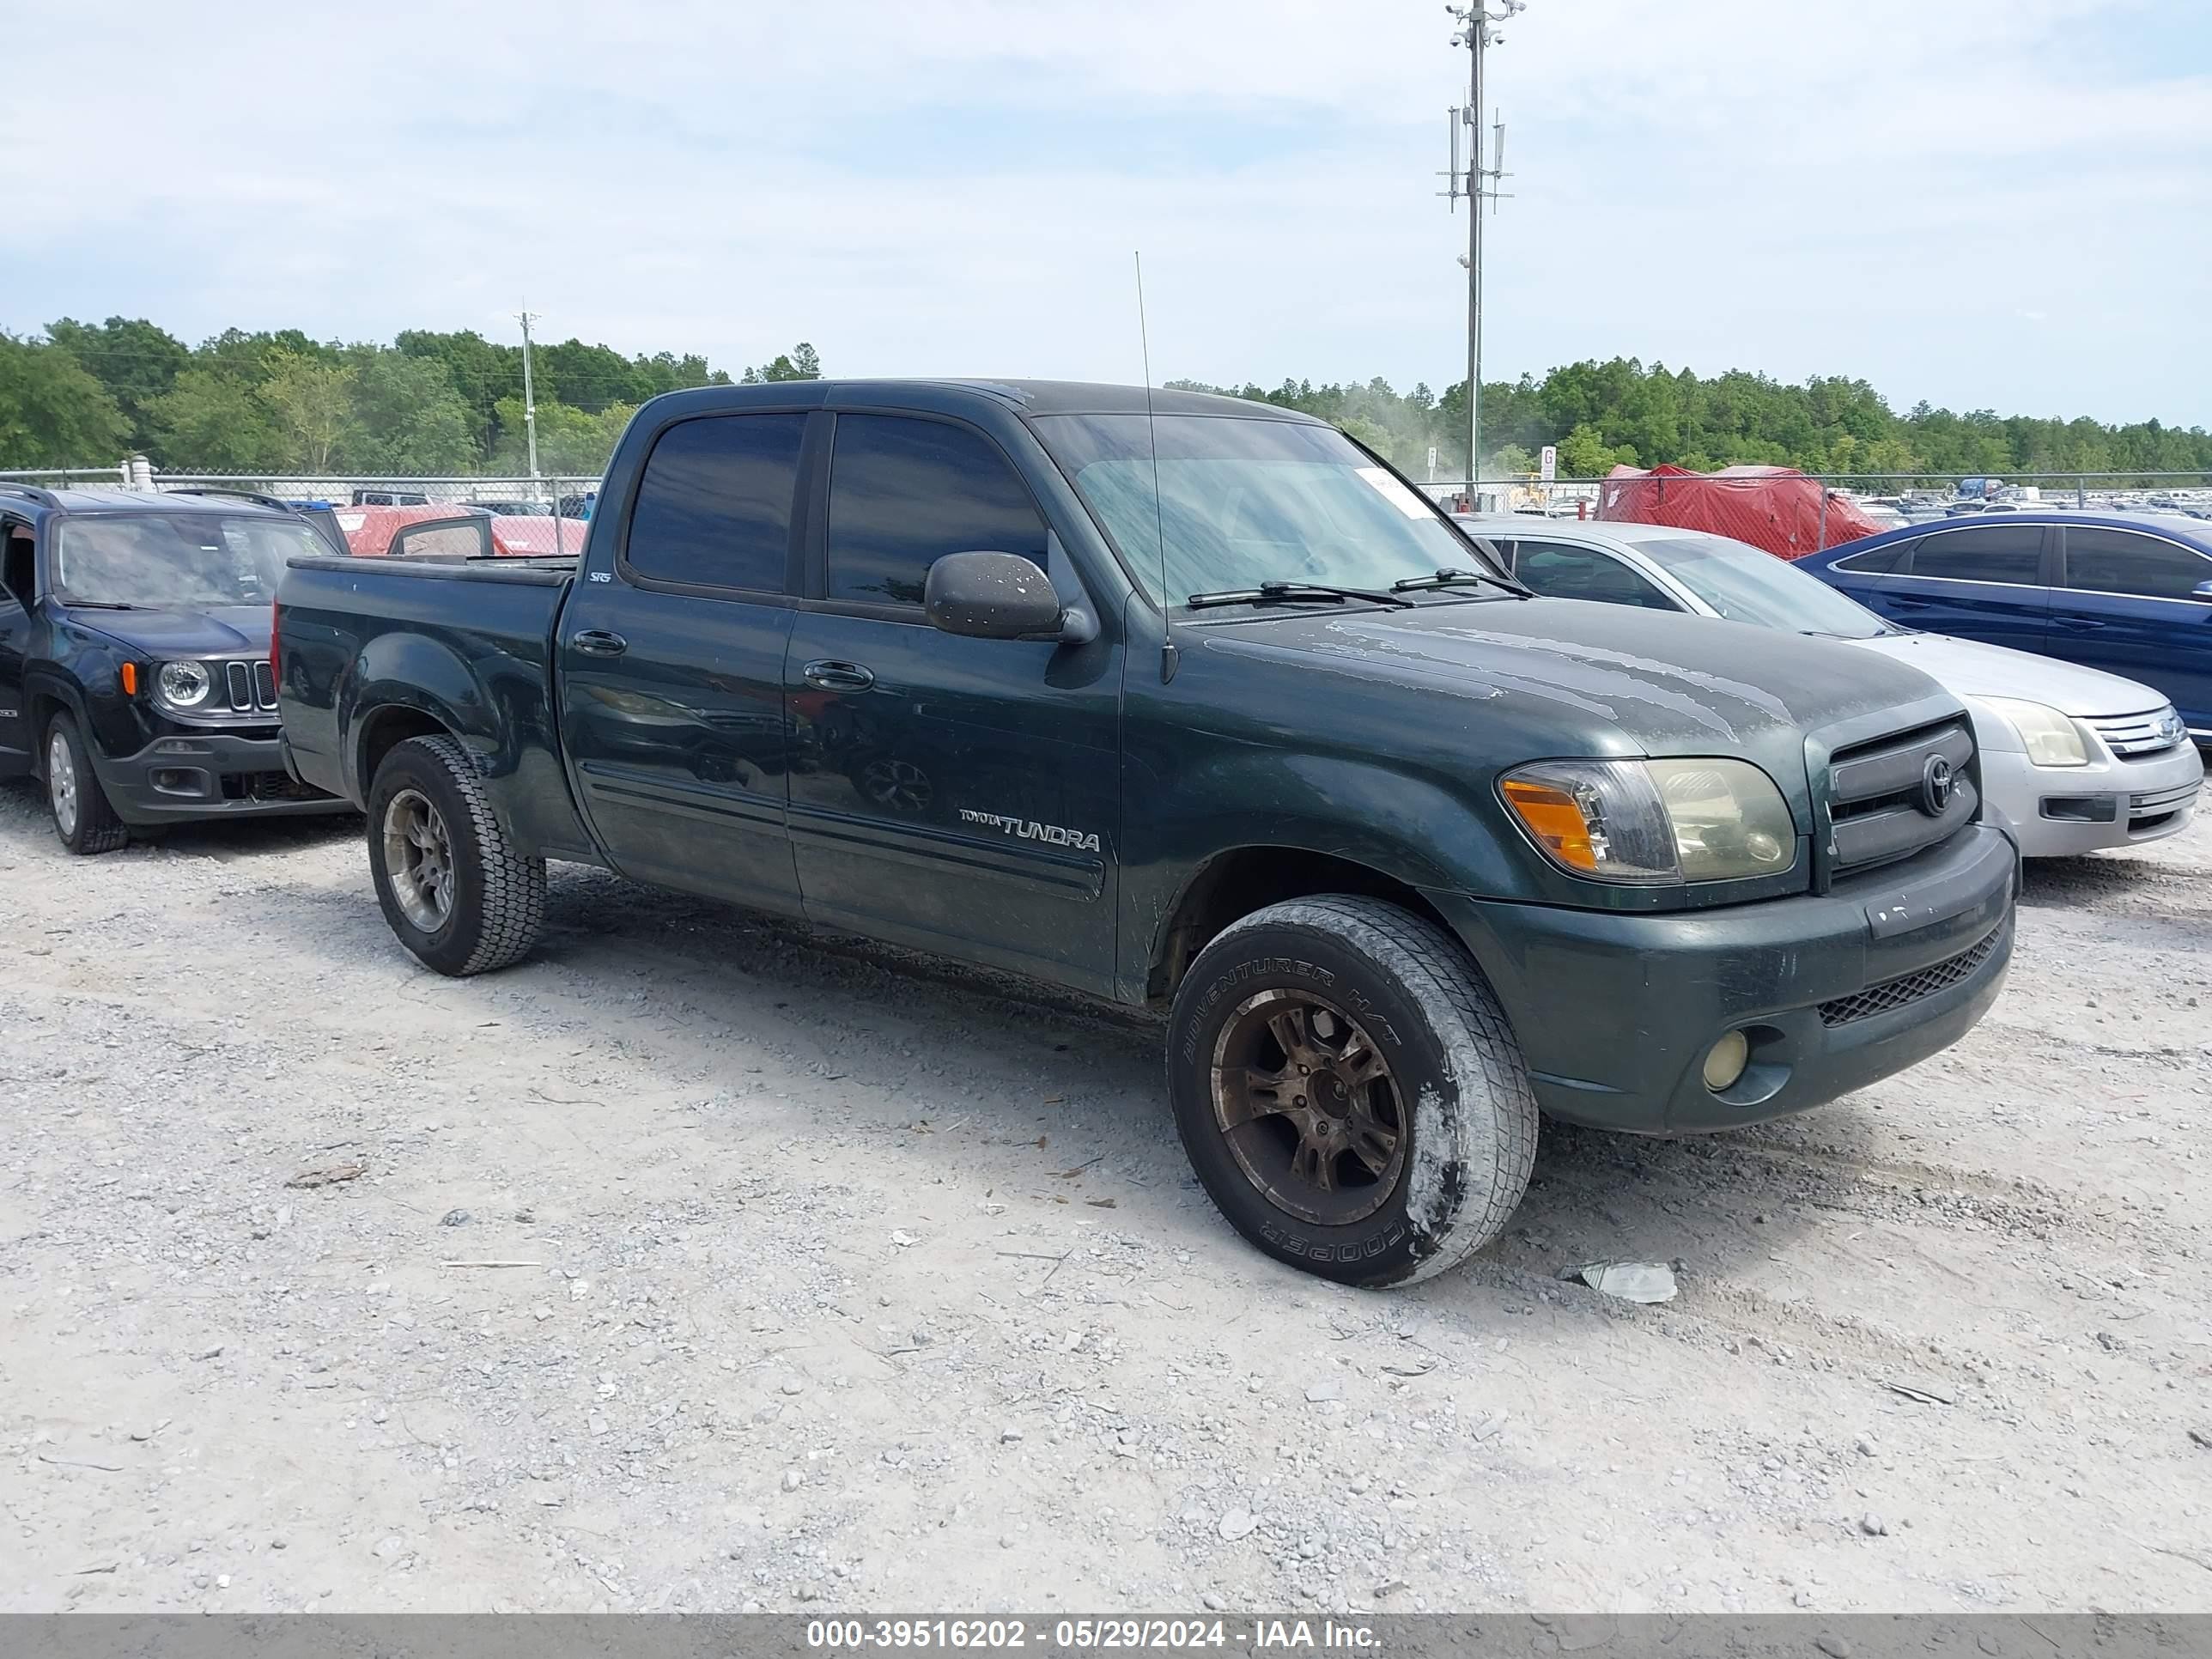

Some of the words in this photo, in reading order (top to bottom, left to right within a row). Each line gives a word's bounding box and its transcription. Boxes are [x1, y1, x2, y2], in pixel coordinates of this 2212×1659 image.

[1546, 450, 1553, 464] G
[959, 809, 1001, 827] TOYOTA
[1000, 816, 1100, 853] TUNDRA
[1183, 957, 1336, 1066] ADVENTURER
[1259, 1217, 1406, 1263] COOPER
